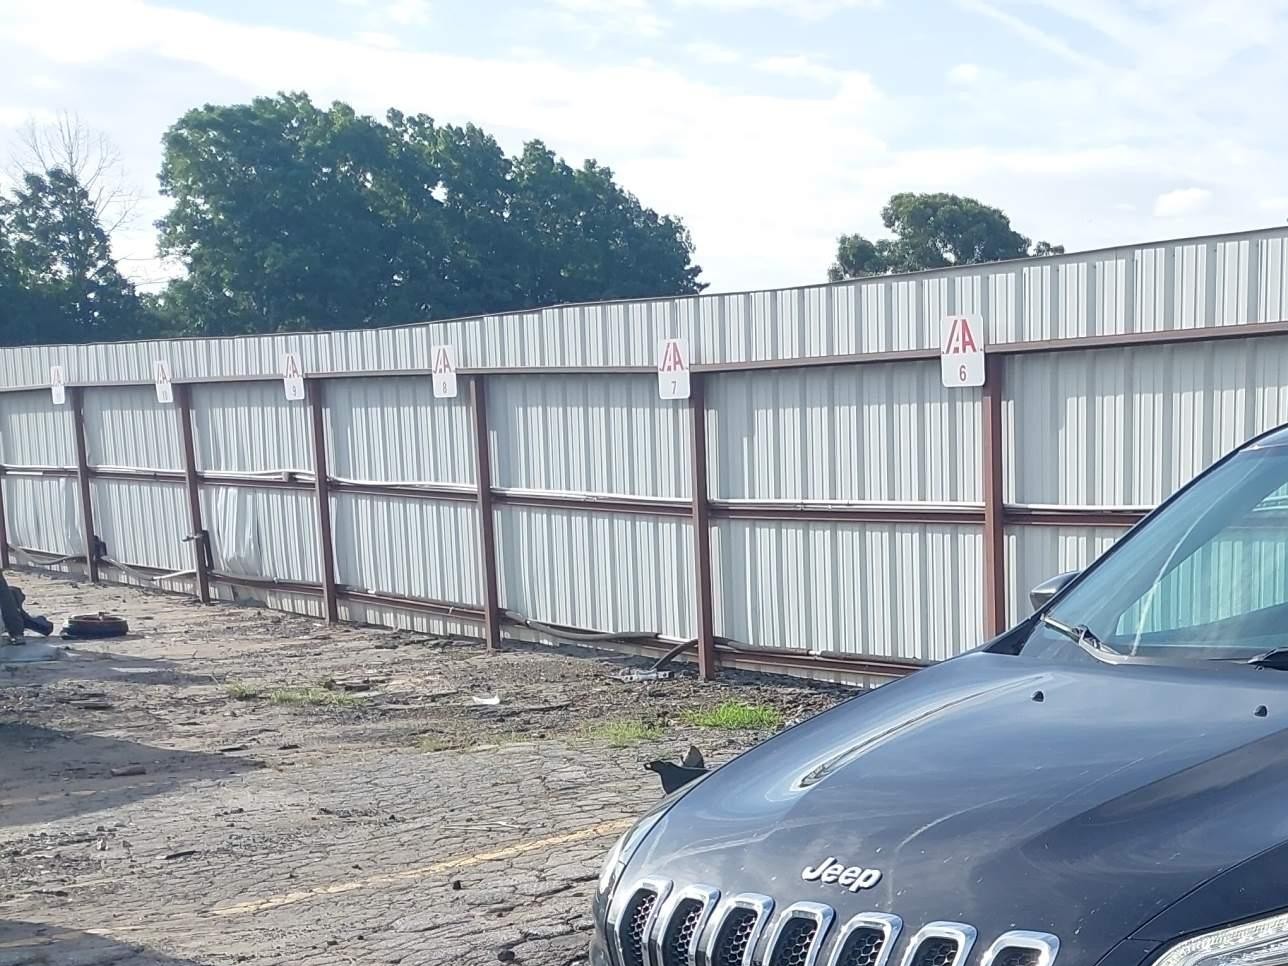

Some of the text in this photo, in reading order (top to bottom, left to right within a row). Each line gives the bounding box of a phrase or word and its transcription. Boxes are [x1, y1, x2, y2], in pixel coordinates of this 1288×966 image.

[959, 364, 967, 382] 6
[671, 380, 677, 395] 7
[801, 856, 882, 893] Jeep
